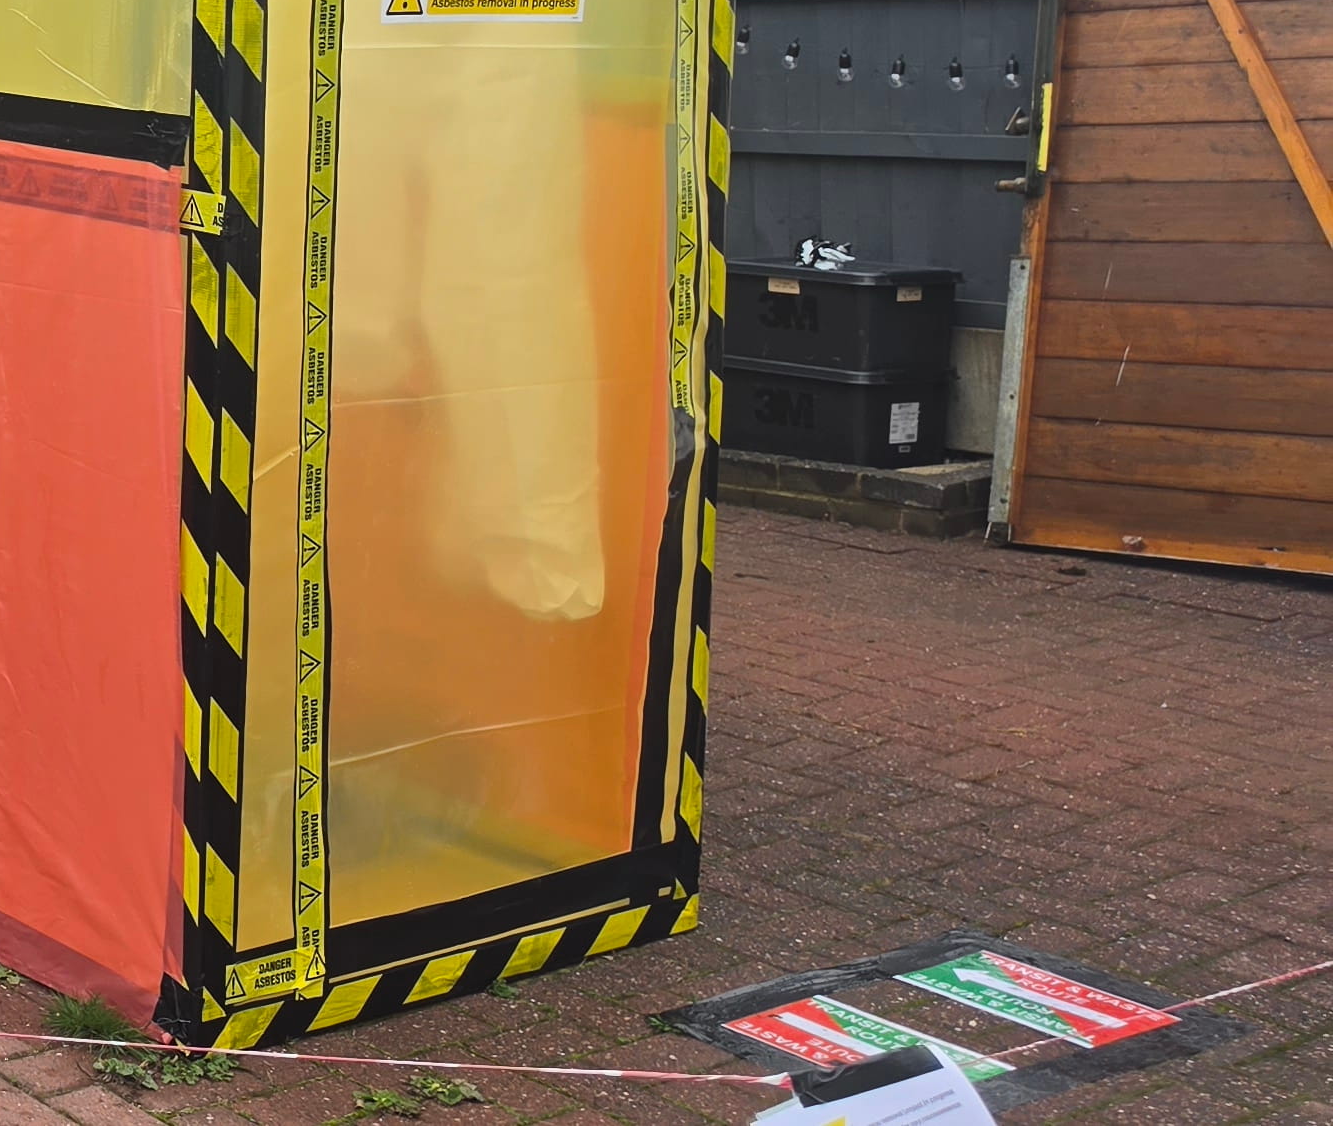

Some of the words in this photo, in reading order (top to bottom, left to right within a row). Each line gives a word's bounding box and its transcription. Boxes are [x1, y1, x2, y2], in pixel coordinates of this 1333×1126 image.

[318, 0, 327, 56] ASBESTOS
[327, 4, 337, 50] DANGER
[315, 115, 323, 173] ASBESTOS
[323, 120, 331, 166] DANGER
[310, 231, 319, 289] ASBESTOS
[319, 236, 328, 282] DANGER
[758, 293, 819, 332] 3M
[307, 347, 316, 404] ASBESTOS
[316, 352, 324, 397] DANGER
[305, 464, 313, 521] ASBESTOS
[313, 467, 322, 513] DANGER
[302, 579, 310, 637] ASBESTOS
[311, 583, 319, 628] DANGER
[310, 699, 318, 744] DANGER
[301, 810, 309, 867] ASBESTOS
[311, 814, 319, 859] DANGER
[254, 970, 296, 989] ASBESTOS
[259, 957, 292, 974] DANGER
[981, 954, 1068, 984] TRANSIT
[1068, 984, 1083, 993] &
[1087, 992, 1165, 1022] WASTE
[909, 974, 983, 1003] WASTE
[982, 988, 1053, 1015] ROUTE
[1014, 979, 1090, 1005] ROUTE
[737, 1020, 809, 1054] WASTE
[806, 1000, 898, 1035] TRANSIT
[897, 1033, 910, 1043] &
[812, 1051, 822, 1060] &
